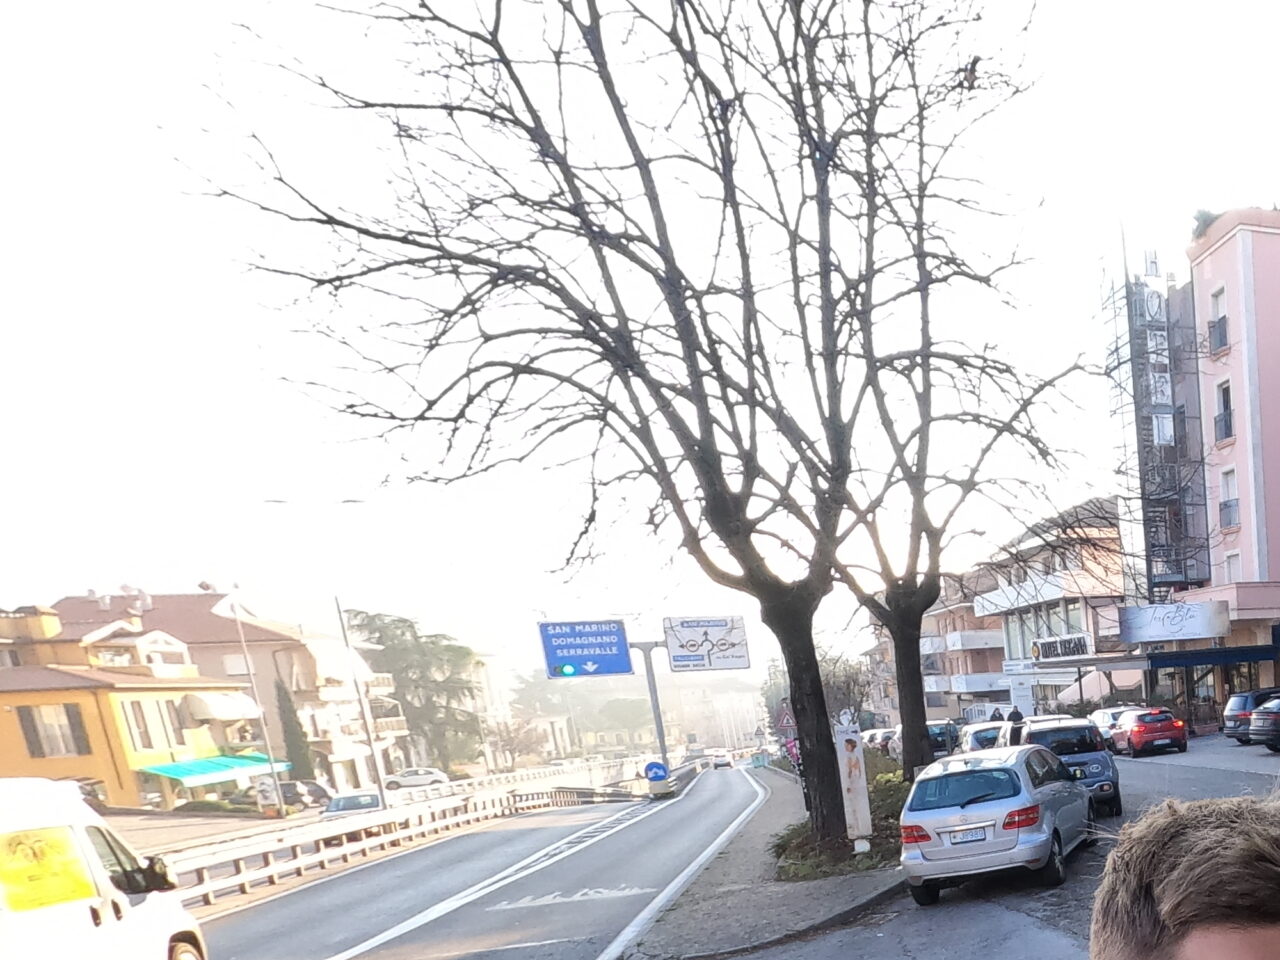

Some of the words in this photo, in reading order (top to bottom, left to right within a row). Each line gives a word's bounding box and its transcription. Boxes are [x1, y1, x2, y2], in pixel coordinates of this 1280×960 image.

[547, 625, 570, 634] SAN
[575, 623, 618, 633] MARINO
[552, 635, 618, 645] DOMAGNANO
[556, 646, 619, 656] SERRAVALLE
